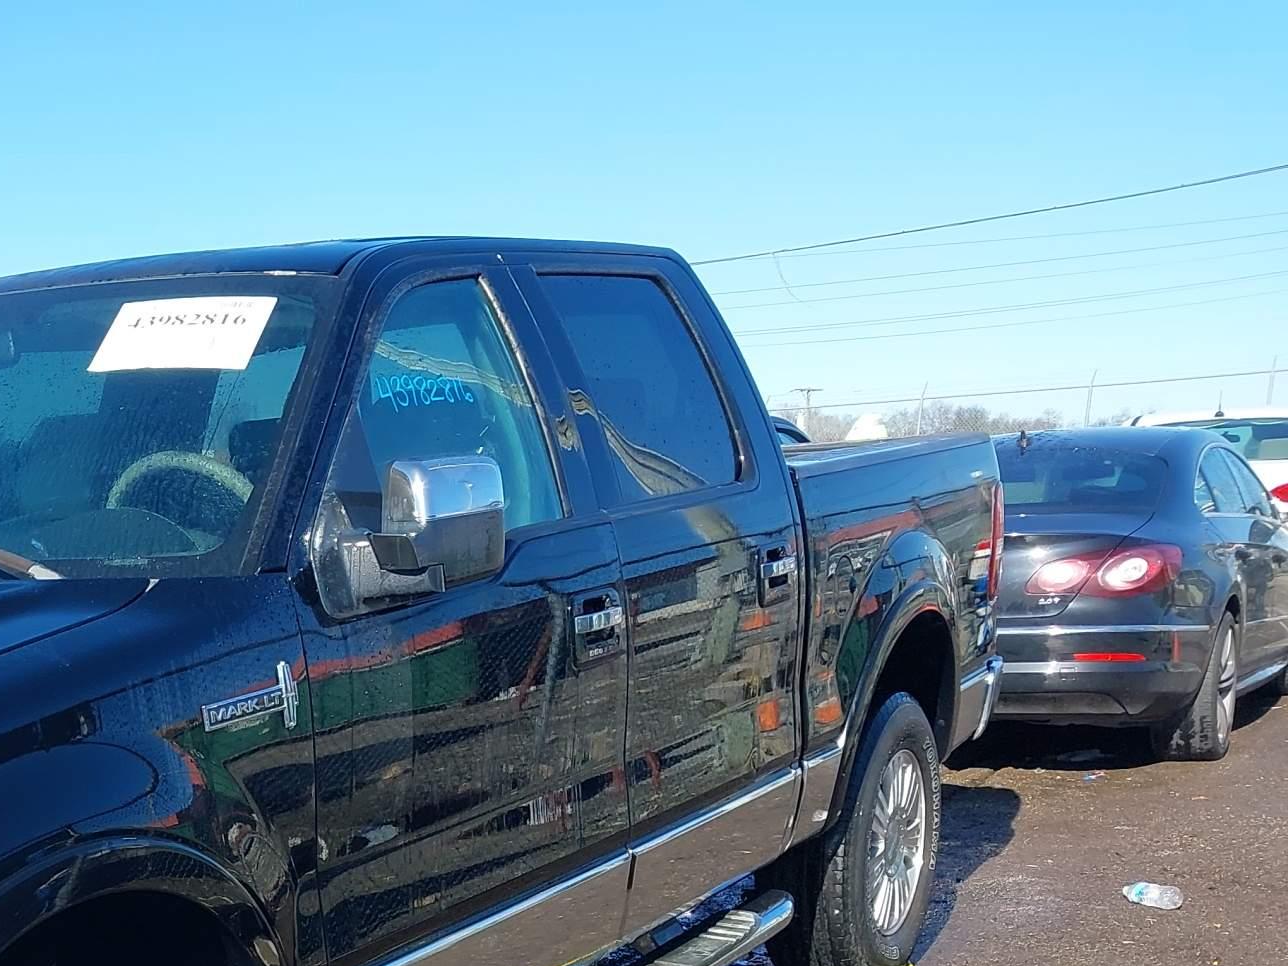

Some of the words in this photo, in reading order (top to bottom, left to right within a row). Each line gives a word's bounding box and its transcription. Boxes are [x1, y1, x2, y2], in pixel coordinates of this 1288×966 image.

[376, 375, 474, 413] 43982816
[210, 698, 261, 723] MARK
[263, 691, 282, 710] LT
